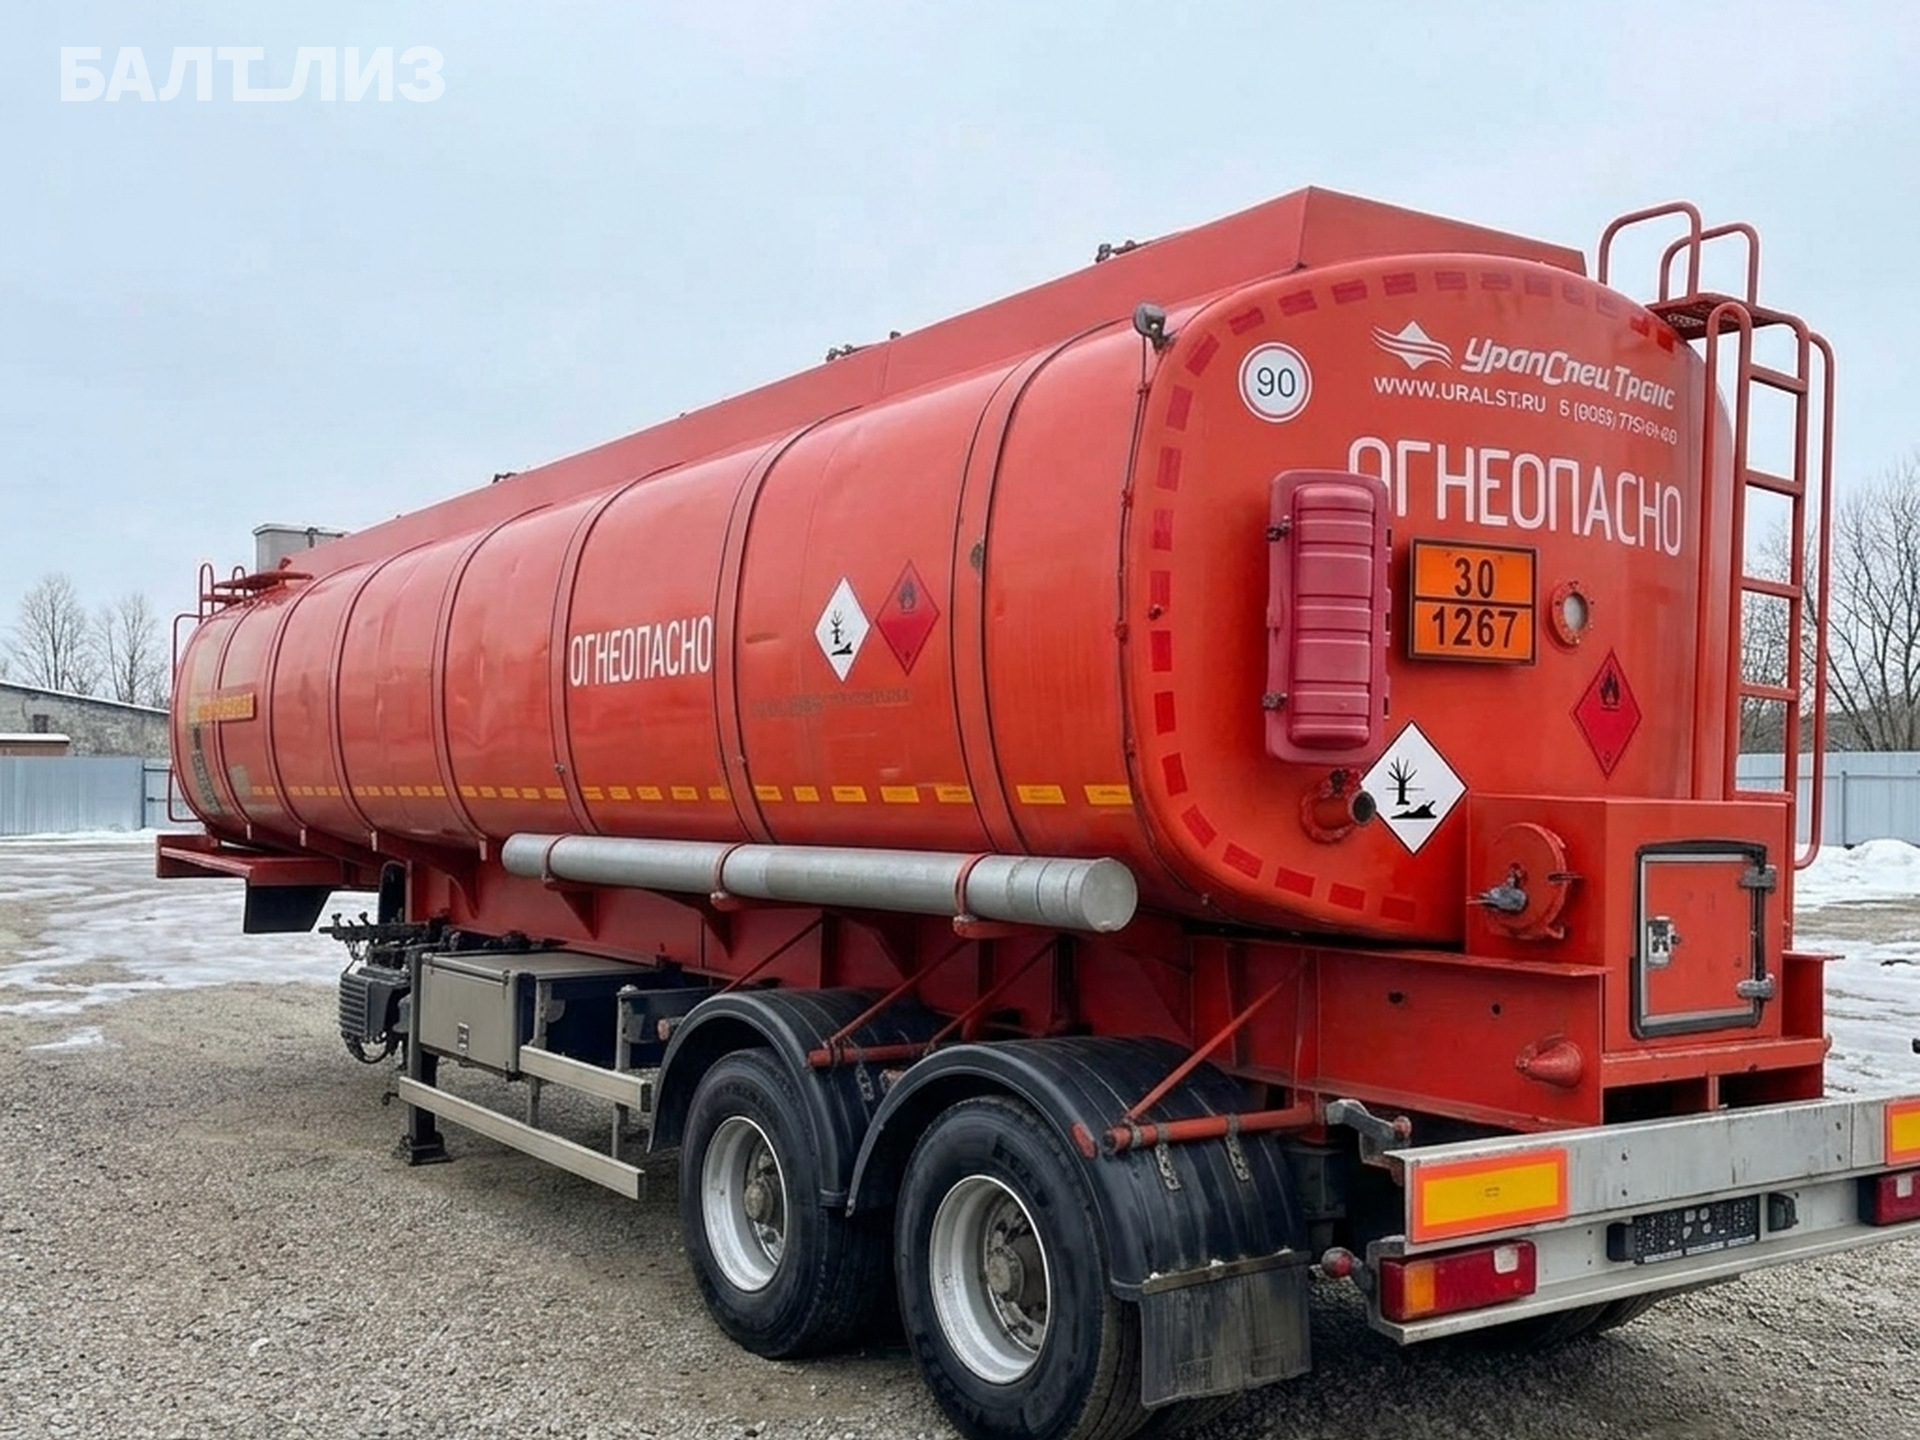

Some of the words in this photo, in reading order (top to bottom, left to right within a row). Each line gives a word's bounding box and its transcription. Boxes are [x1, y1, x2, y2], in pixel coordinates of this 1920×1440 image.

[1257, 366, 1296, 398] 90
[1373, 376, 1547, 413] WWW.URALST.RU
[1454, 557, 1495, 600] 30
[1431, 605, 1519, 649] 1267
[570, 614, 713, 687] ОГНЕОПАСНО
